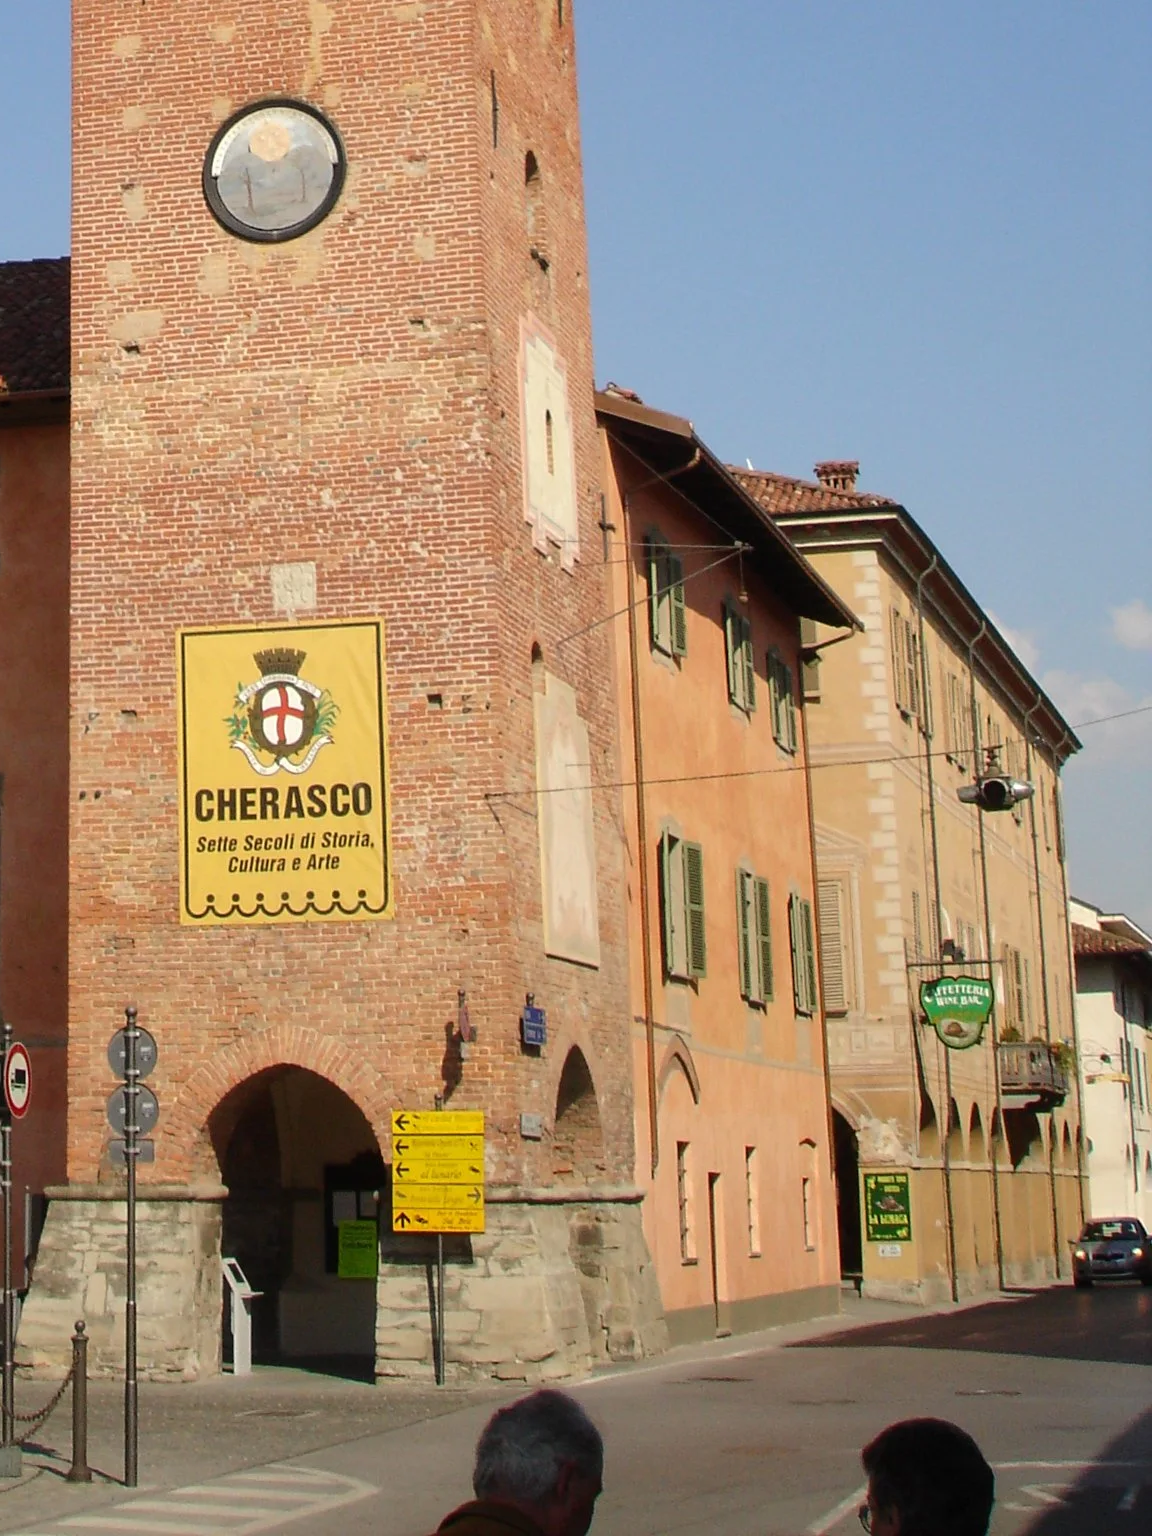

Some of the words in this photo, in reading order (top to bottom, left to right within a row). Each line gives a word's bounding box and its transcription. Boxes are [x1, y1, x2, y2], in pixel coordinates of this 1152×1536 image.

[195, 782, 373, 822] CHERASCO
[196, 836, 238, 853] Sette
[243, 833, 295, 852] Secoli
[300, 832, 316, 849] di
[321, 830, 375, 849] Storia,
[228, 855, 286, 873] Cultura
[292, 857, 301, 871] e
[306, 853, 340, 871] Arte
[936, 996, 958, 1006] WINE
[959, 995, 984, 1007] BAR
